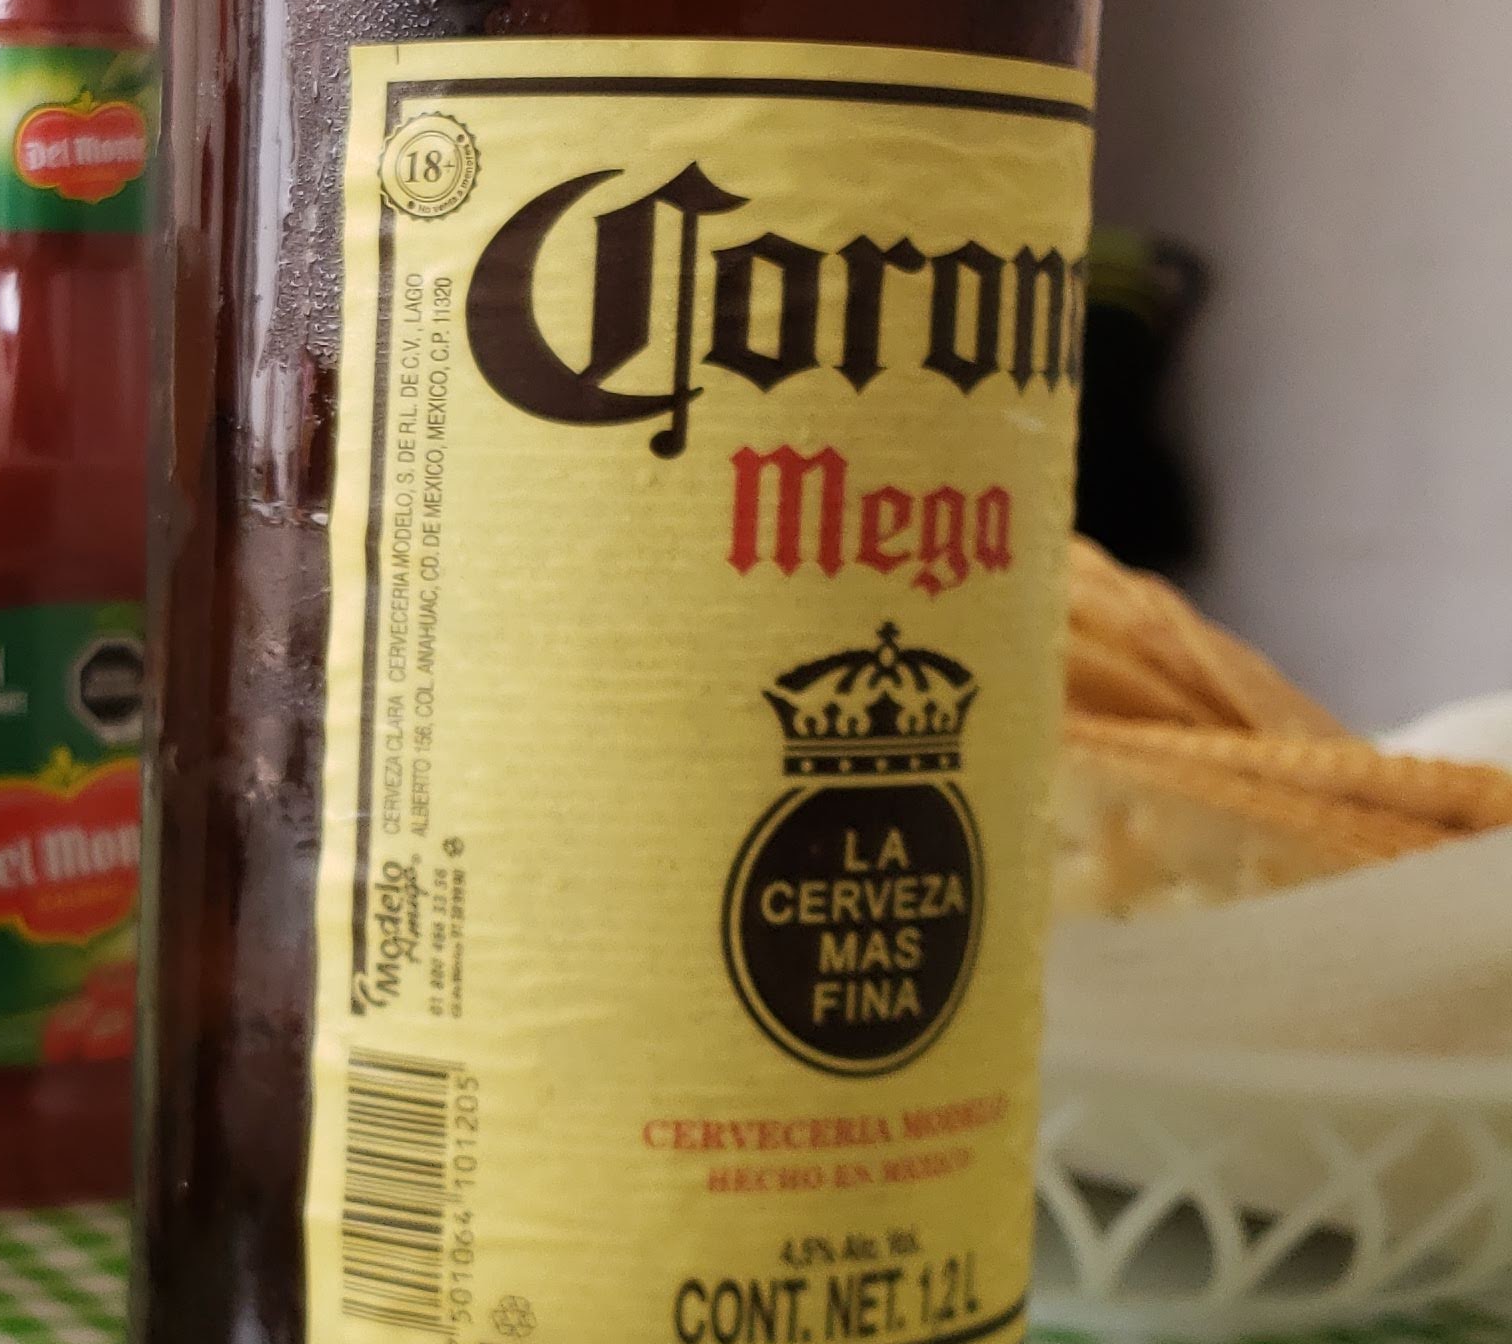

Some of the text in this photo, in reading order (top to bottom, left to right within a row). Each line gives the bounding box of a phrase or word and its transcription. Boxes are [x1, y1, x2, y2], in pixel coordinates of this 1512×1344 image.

[405, 150, 456, 183] 18+
[403, 273, 424, 324] LAGO
[433, 277, 453, 323] 11320
[430, 330, 450, 362] C.P.
[400, 373, 419, 398] DE
[426, 366, 450, 441] MEXICO,
[398, 438, 417, 463] DE
[424, 445, 447, 519] MEXICO,
[391, 487, 416, 568] MODELO,
[423, 523, 441, 547] DE
[728, 444, 1014, 601] Mega
[420, 551, 441, 581] CD.
[388, 571, 410, 683] CERVECERIA
[417, 585, 441, 675] ANAHUAC,
[385, 695, 404, 752] CLARA
[382, 755, 403, 835] CERVEZA
[411, 759, 431, 838] ALBERTO
[844, 827, 910, 872] LA
[759, 873, 966, 925] CERVEZA
[375, 860, 404, 998] Modelo
[819, 926, 924, 974] MAS
[812, 977, 923, 1025] FINA
[454, 1075, 479, 1189] 101205
[641, 1115, 892, 1153] CERVECERIA
[707, 1163, 825, 1194] HECHO
[449, 1210, 474, 1324] 501064
[825, 1267, 906, 1341] NET.
